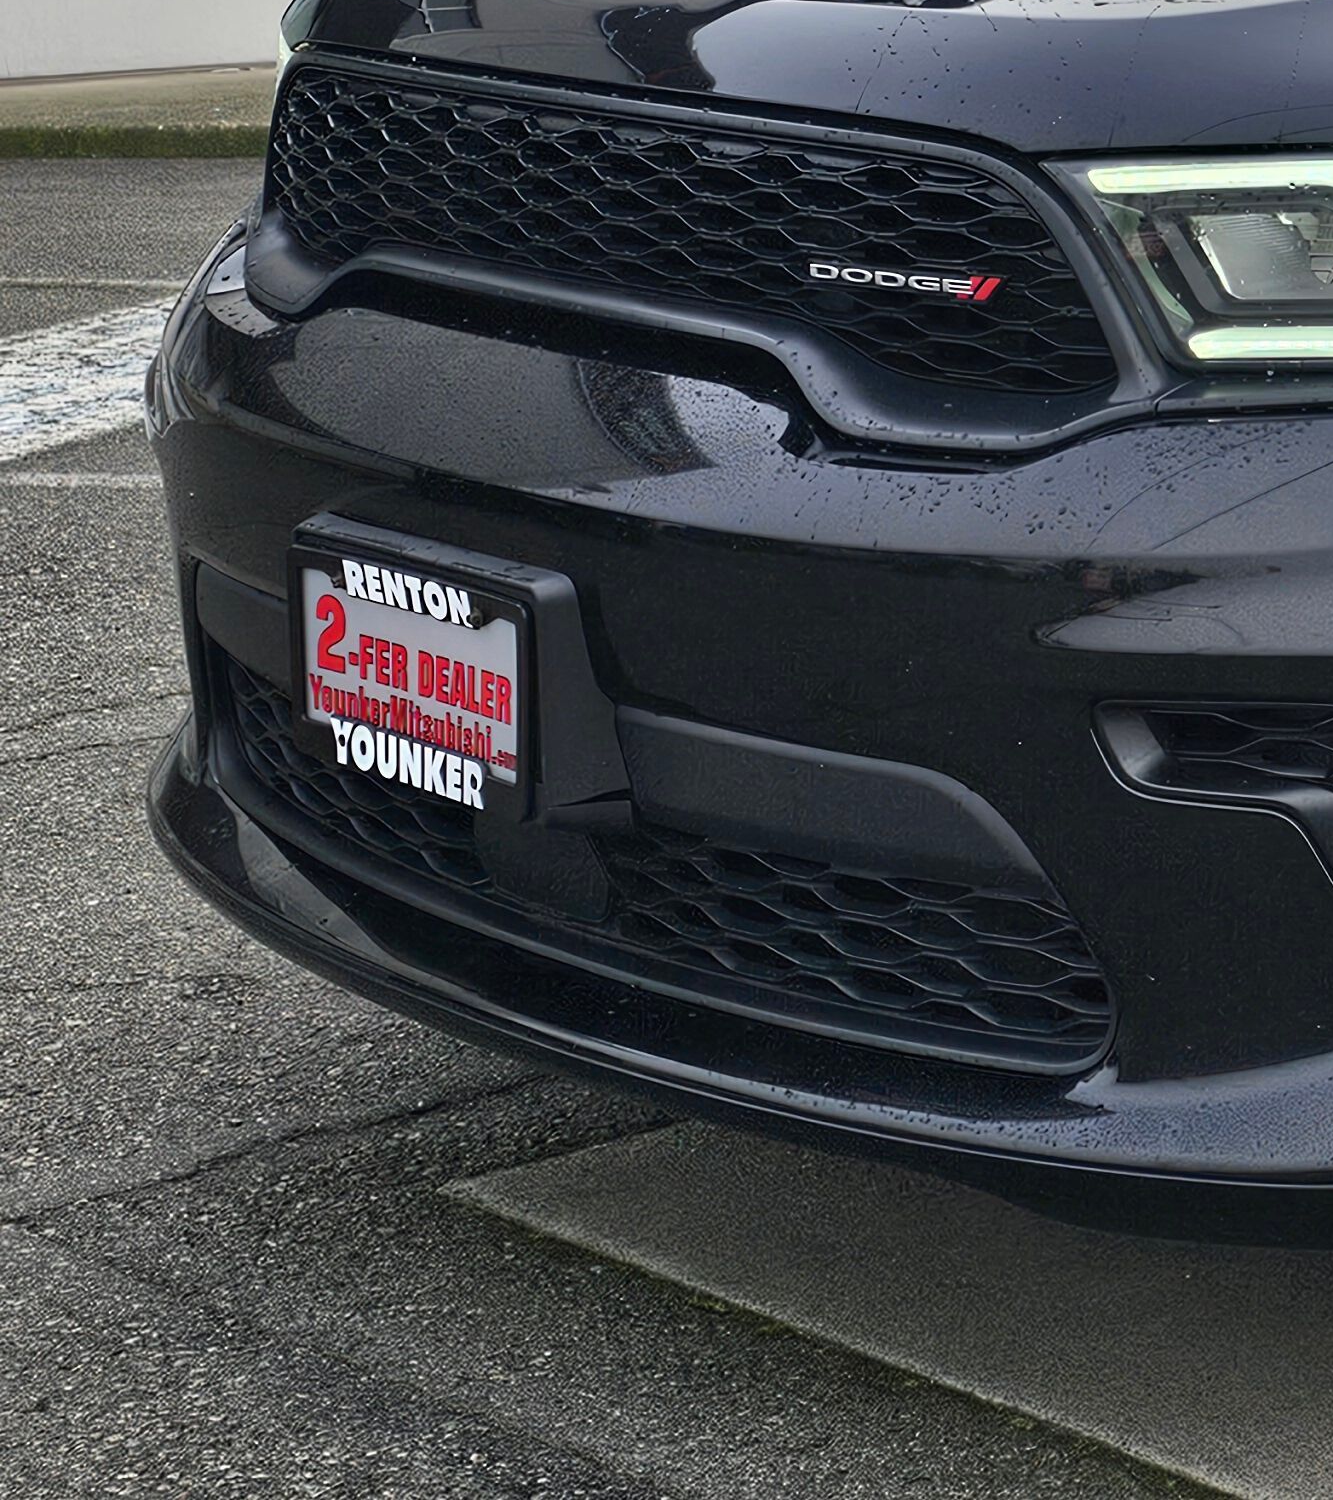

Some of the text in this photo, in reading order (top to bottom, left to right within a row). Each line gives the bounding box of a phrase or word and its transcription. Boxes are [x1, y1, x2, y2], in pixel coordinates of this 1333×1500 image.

[809, 263, 974, 295] DODGE
[342, 559, 475, 628] RENTON
[316, 594, 512, 725] 2-FER DEALER
[330, 716, 484, 810] YOUNKER
